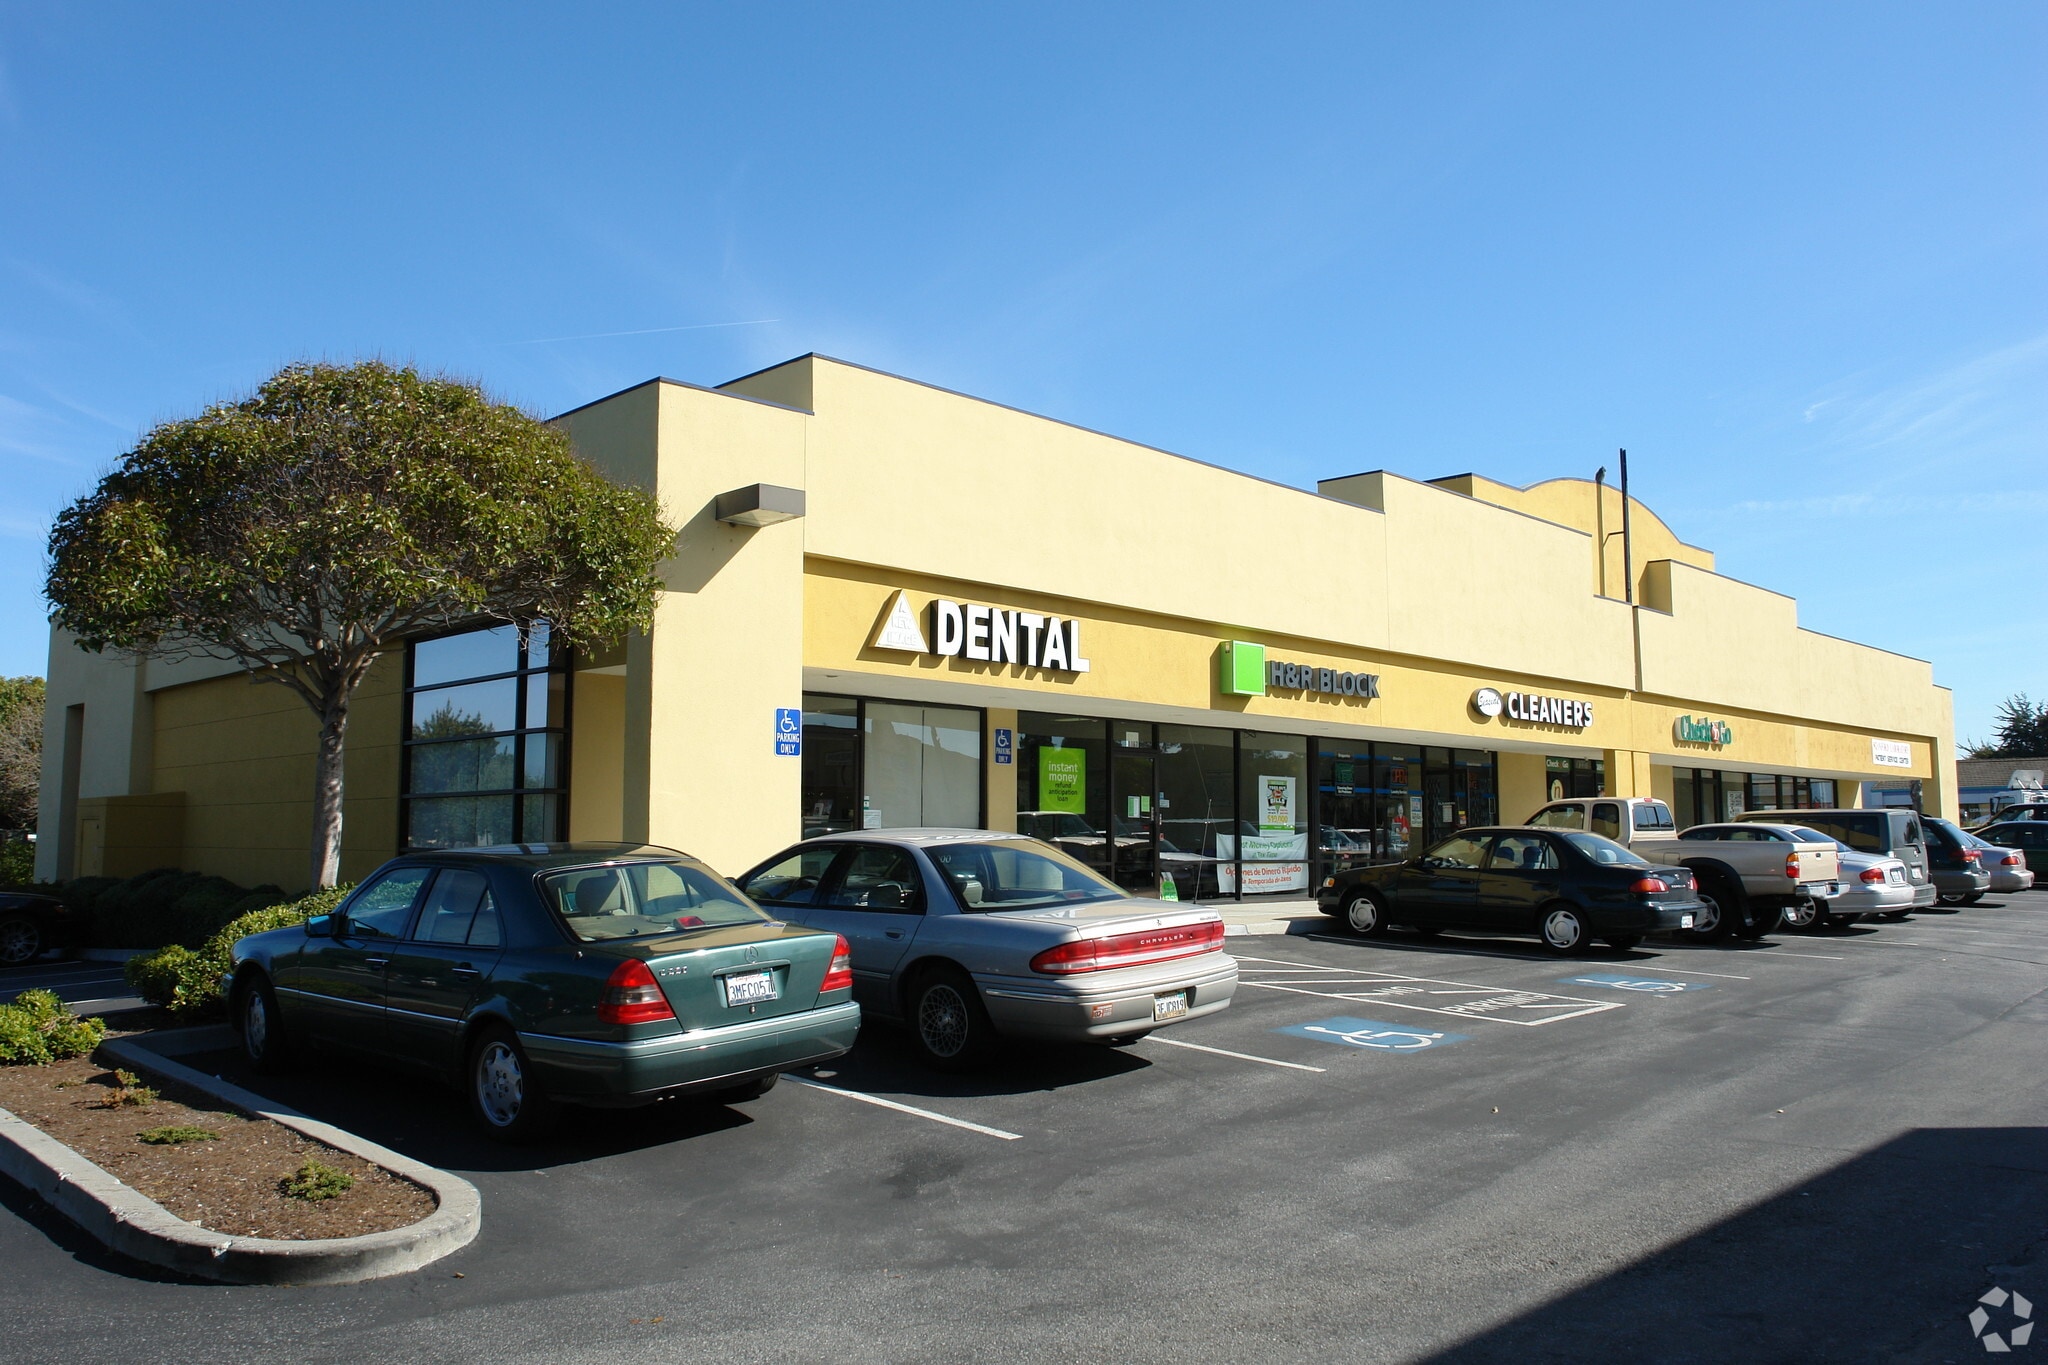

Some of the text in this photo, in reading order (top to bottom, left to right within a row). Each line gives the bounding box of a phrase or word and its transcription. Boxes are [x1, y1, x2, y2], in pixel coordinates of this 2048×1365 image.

[934, 599, 1090, 673] DENTAL
[1270, 660, 1380, 698] H&R BLOCK
[1507, 691, 1594, 728] CLEANERS
[776, 732, 800, 743] PARKING
[1680, 714, 1711, 743] Check
[1718, 720, 1732, 745] Go
[780, 743, 796, 754] ONLY
[1048, 761, 1078, 772] instant
[1048, 773, 1078, 785] money
[1249, 840, 1270, 850] Money
[1140, 933, 1184, 945] CHRYSLER
[729, 980, 773, 1000] 3MFC057
[1438, 993, 1550, 1015] PARKING
